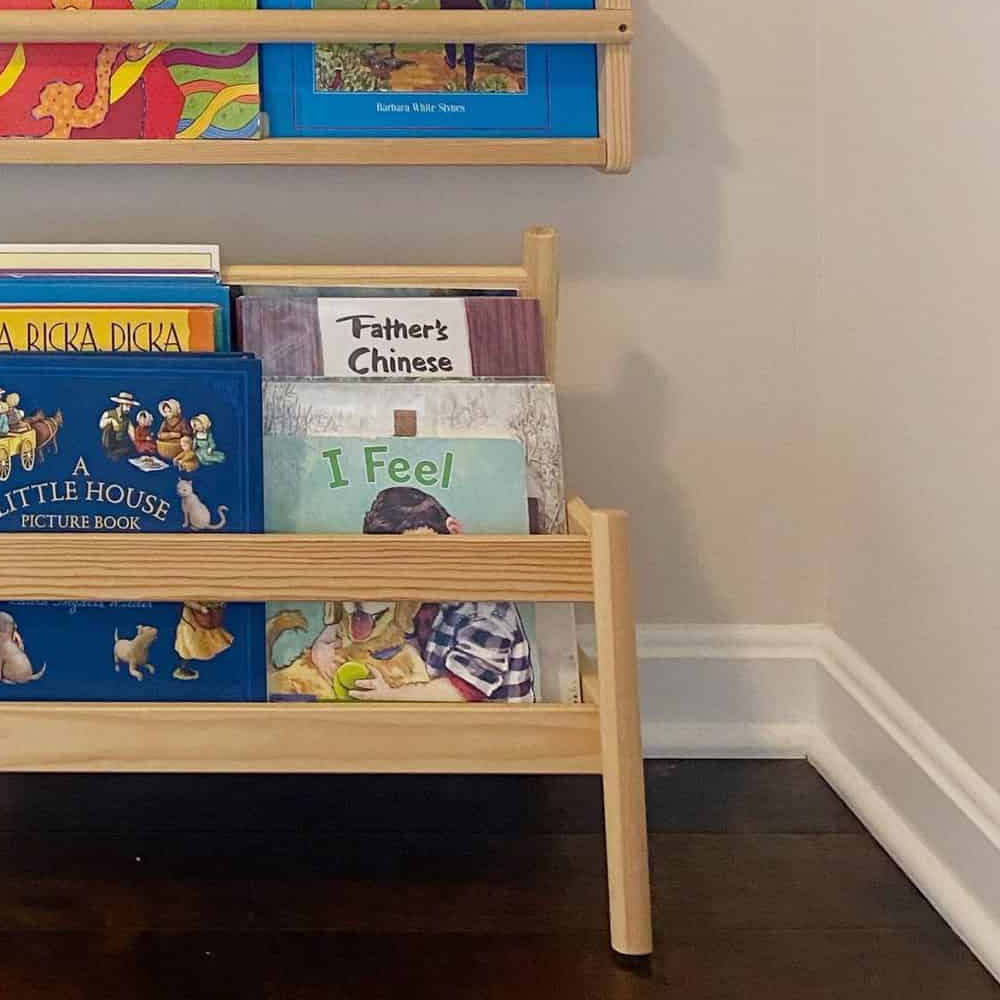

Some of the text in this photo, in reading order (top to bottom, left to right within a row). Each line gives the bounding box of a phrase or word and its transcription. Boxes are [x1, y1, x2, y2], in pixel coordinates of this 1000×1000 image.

[376, 101, 410, 112] Barbara
[412, 101, 437, 112] White
[111, 322, 183, 351] DICKA
[336, 315, 449, 341] Father's
[348, 347, 453, 375] Chinese
[72, 456, 90, 476] A
[322, 446, 454, 489] I Feel
[86, 481, 170, 521] HOUSE
[21, 514, 141, 530] PICTURE BOOK
